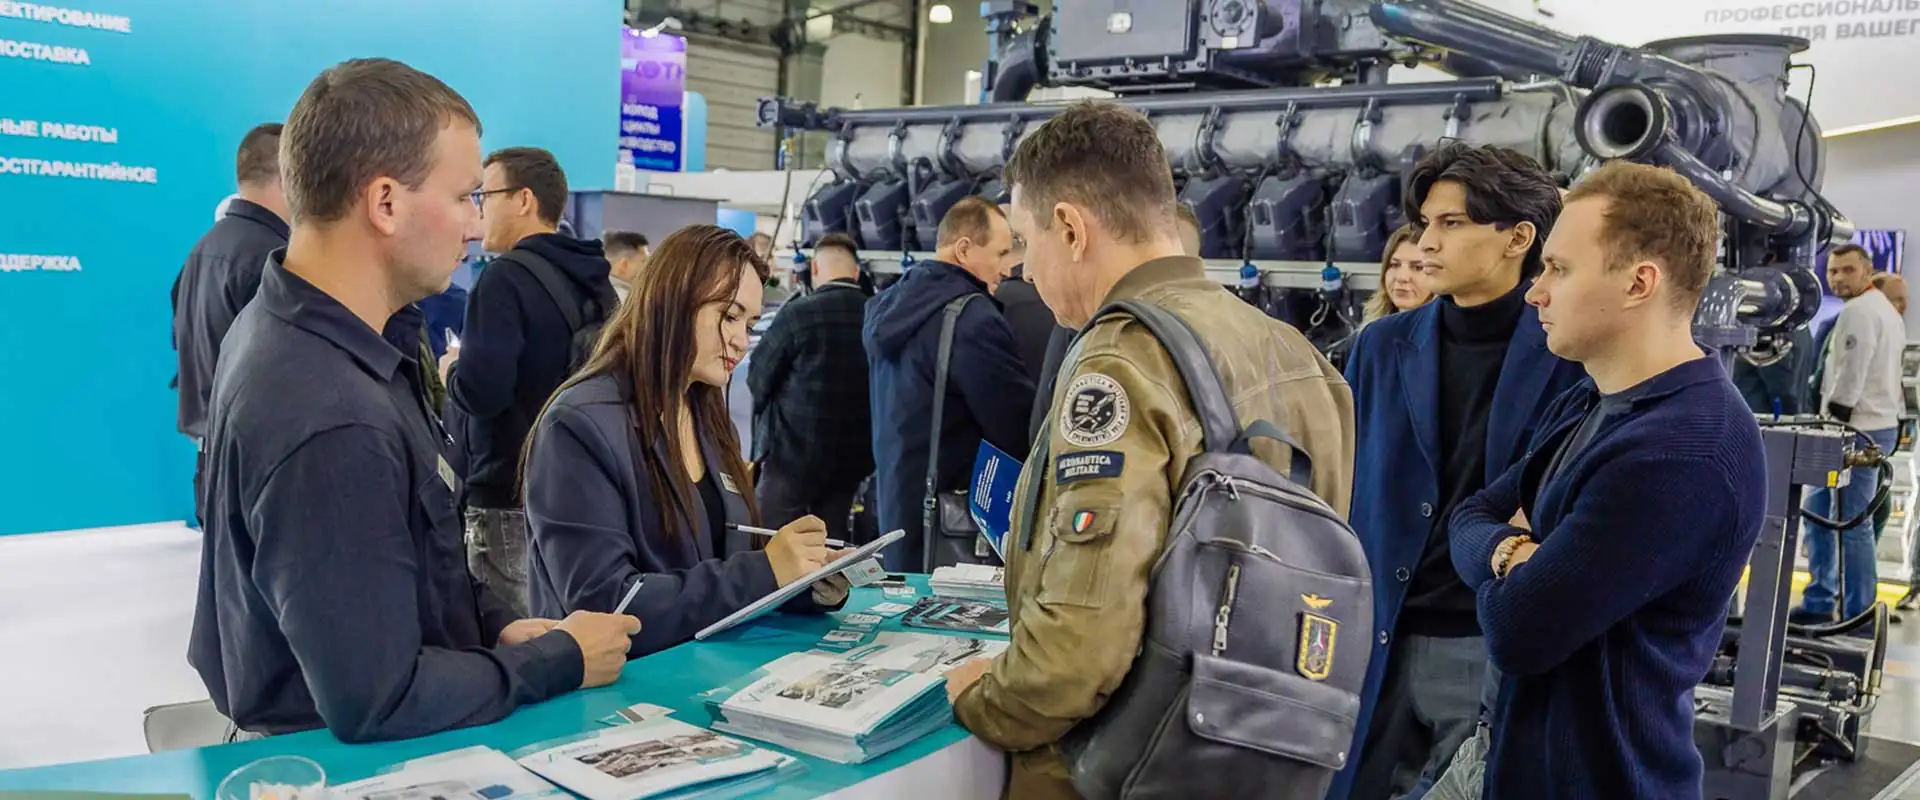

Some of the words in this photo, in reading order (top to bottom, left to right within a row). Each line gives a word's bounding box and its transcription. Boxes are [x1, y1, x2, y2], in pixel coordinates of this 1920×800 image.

[42, 121, 118, 143] РАБОТЫ
[1059, 455, 1111, 470] AERONAUTICA
[1064, 465, 1100, 478] MILITARE
